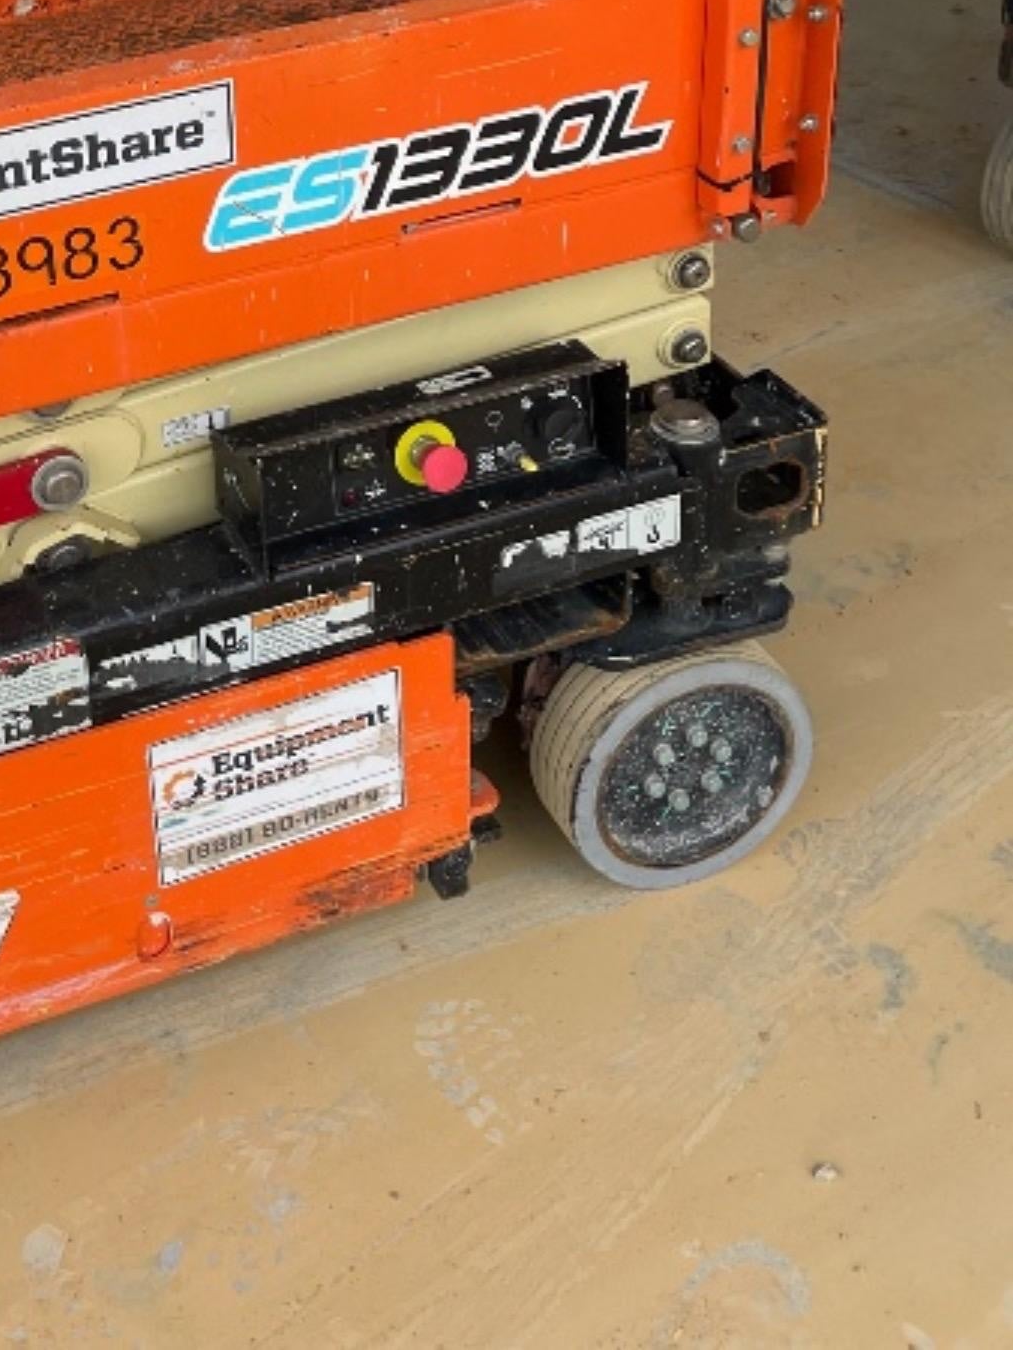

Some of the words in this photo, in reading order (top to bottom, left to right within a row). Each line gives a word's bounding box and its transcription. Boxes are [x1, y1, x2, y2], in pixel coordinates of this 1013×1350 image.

[206, 84, 670, 251] ES1330L
[211, 704, 389, 777] Equipment
[213, 757, 309, 801] Share
